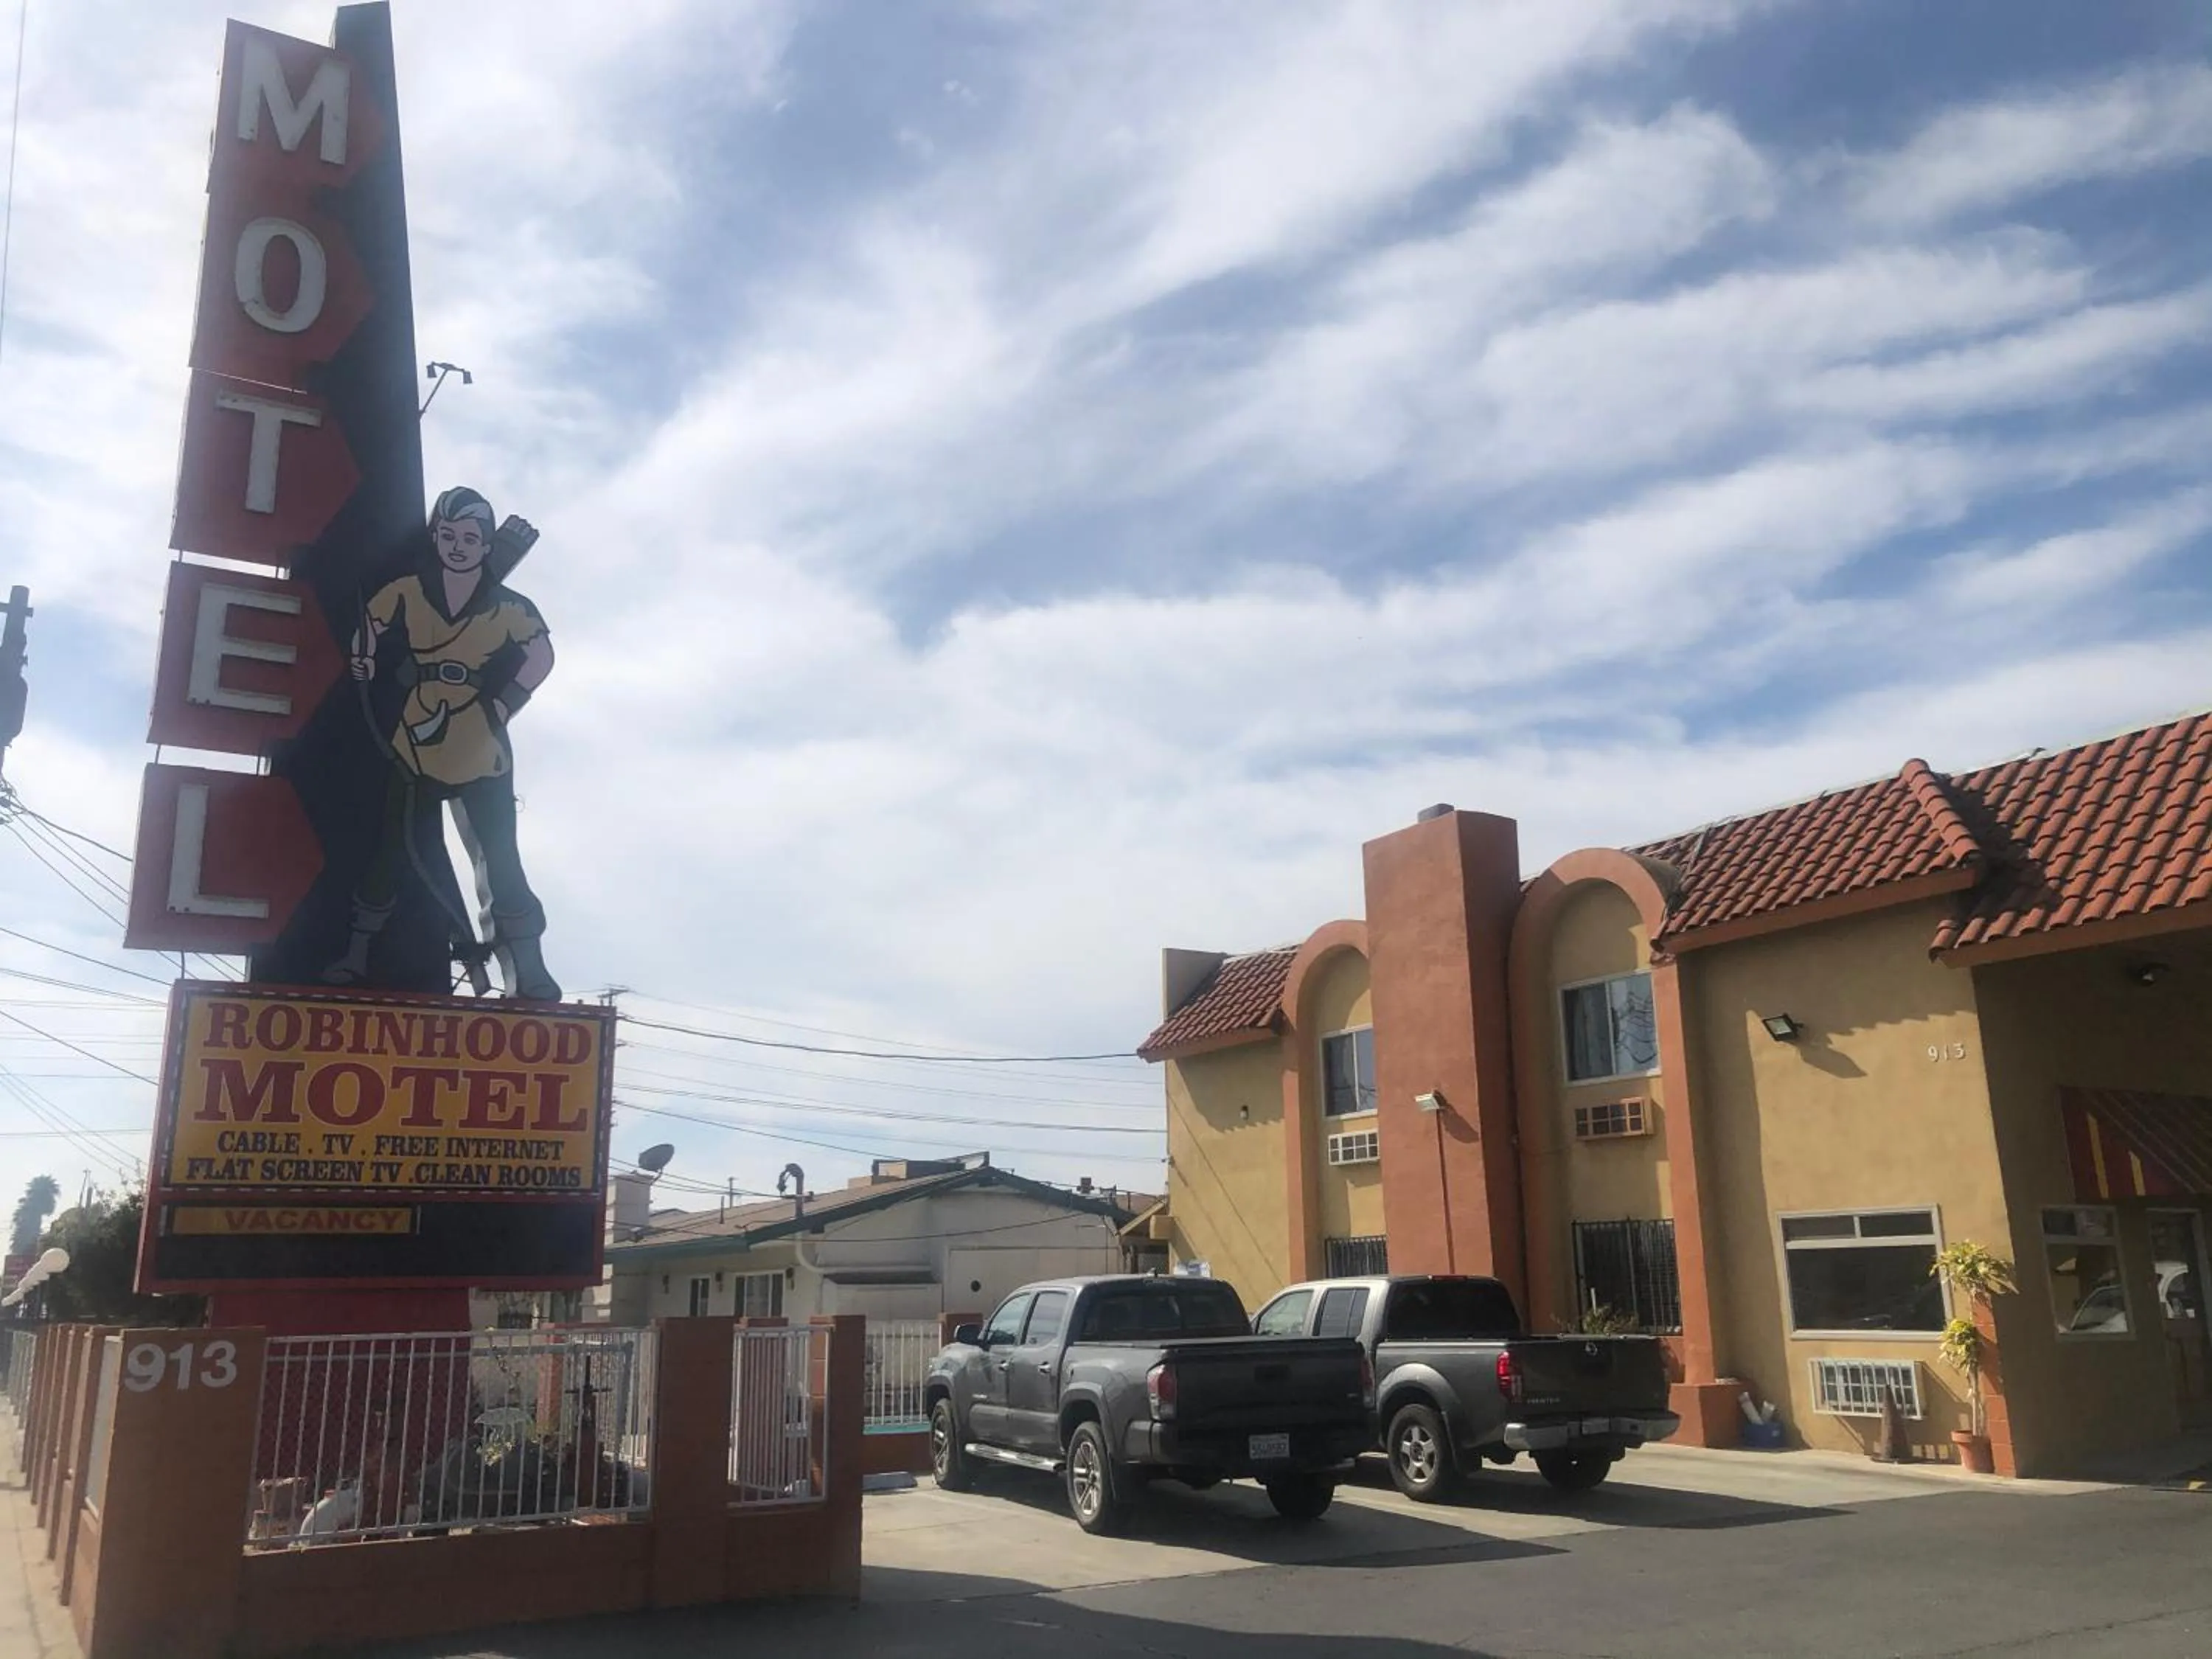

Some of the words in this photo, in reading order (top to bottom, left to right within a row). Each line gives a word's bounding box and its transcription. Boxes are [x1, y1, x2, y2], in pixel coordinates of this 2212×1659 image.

[167, 34, 351, 919] MOTEL
[203, 1002, 592, 1065] ROBINHOOD
[193, 1058, 589, 1133] MOTEL
[186, 1157, 254, 1180] FLAT
[260, 1158, 364, 1182] SCREEN
[369, 1161, 403, 1183] TV
[497, 1165, 581, 1187] ROOMS
[217, 1130, 301, 1155] CABLE
[322, 1133, 355, 1155] TV
[374, 1135, 439, 1157] FREE
[445, 1136, 564, 1161] INTERNET
[225, 1209, 403, 1231] VACANCY
[124, 1340, 237, 1393] 913
